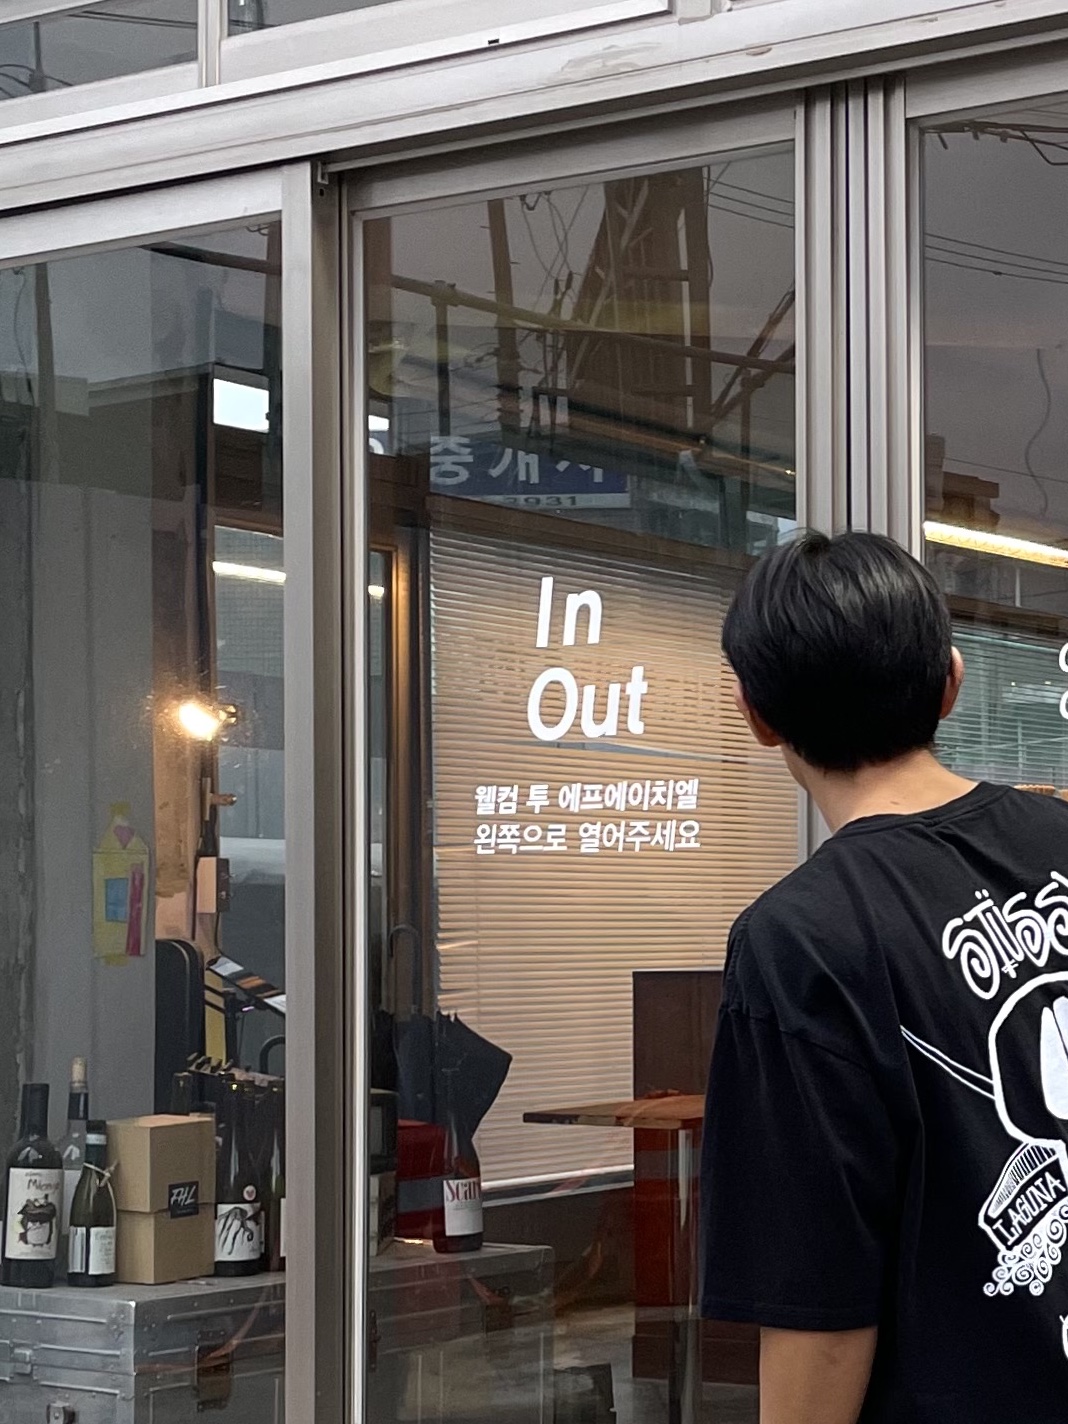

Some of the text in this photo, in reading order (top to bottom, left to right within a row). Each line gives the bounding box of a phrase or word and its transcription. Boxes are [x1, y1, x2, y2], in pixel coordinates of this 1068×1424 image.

[535, 576, 602, 648] In
[527, 665, 648, 742] Out
[474, 778, 700, 816] 웰컴 투 에프에이치엘
[473, 819, 701, 855] 왼쪽으로 열어주세요
[992, 1171, 1067, 1246] LAGUNA
